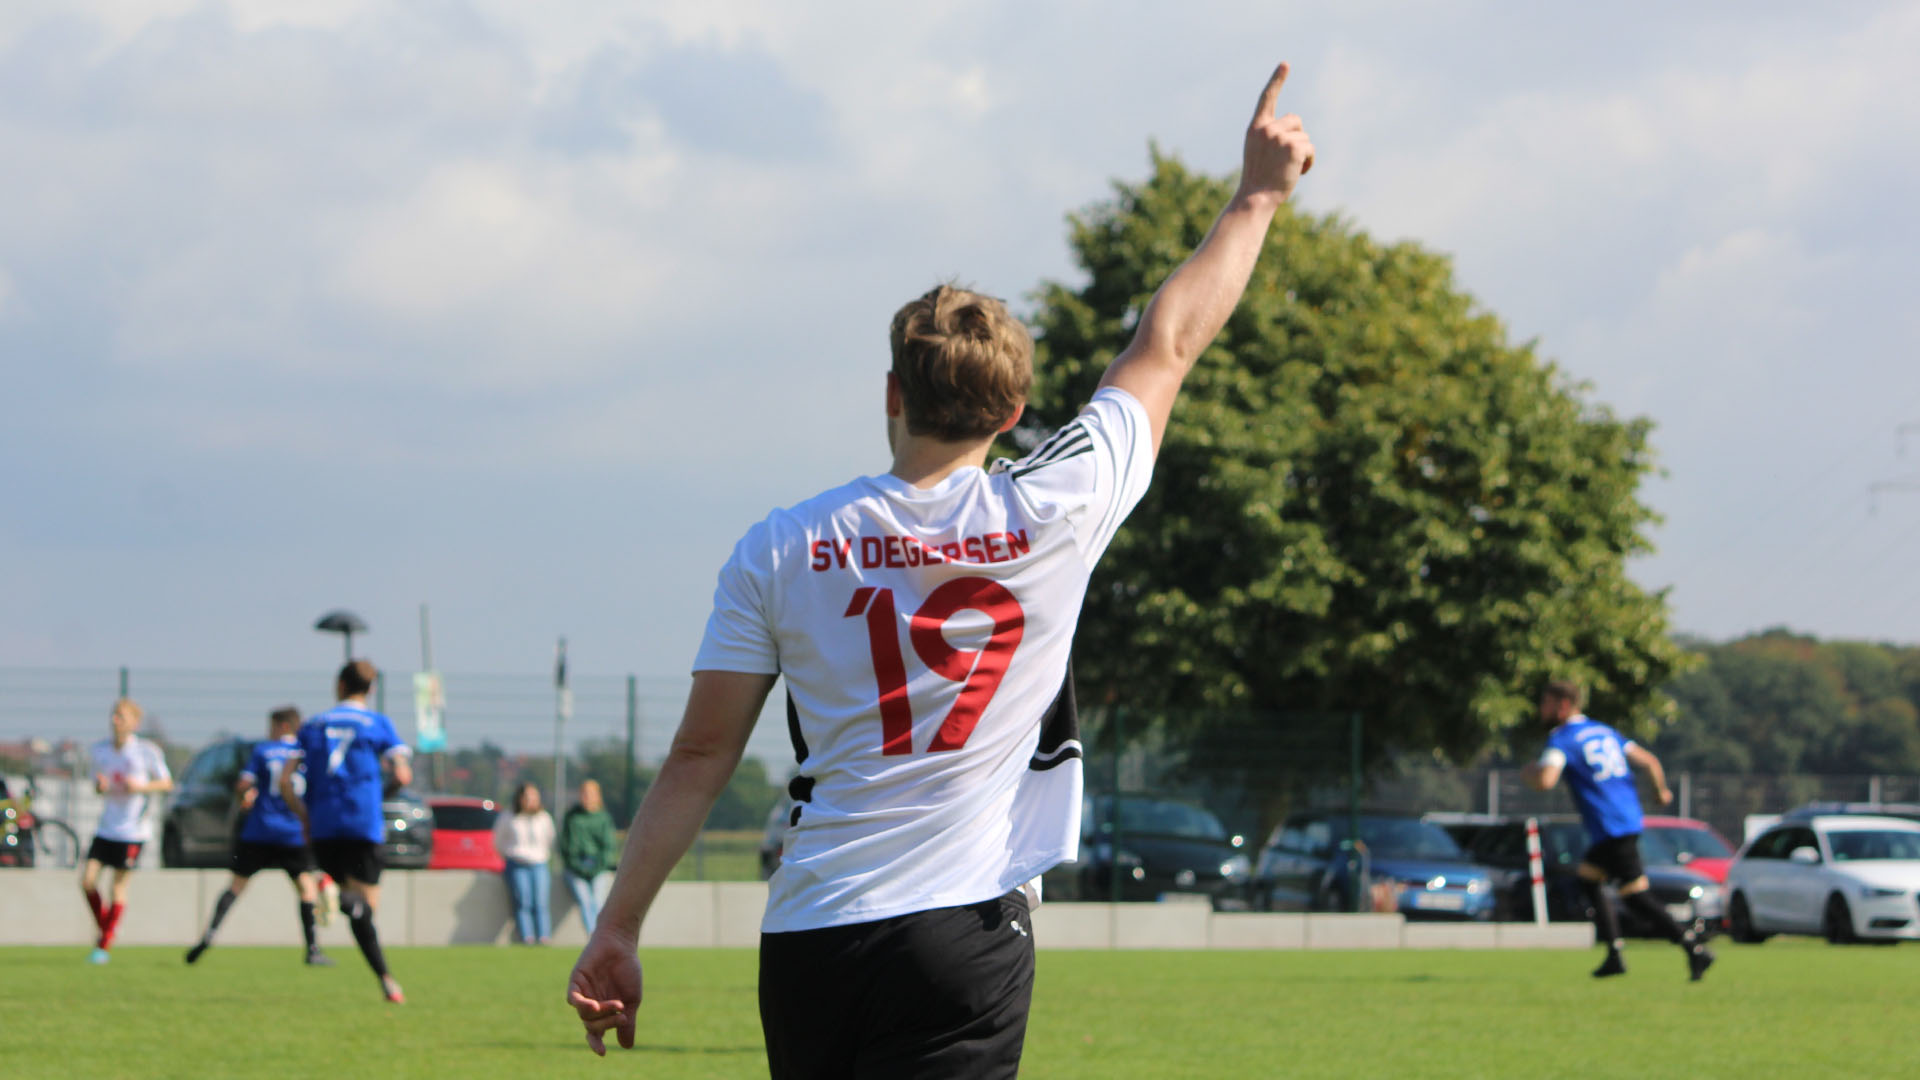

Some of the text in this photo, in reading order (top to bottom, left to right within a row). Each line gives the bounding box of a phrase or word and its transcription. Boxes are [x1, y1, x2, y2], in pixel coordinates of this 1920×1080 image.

[811, 538, 851, 572] SV
[844, 576, 1025, 756] 19
[325, 726, 355, 775] 7
